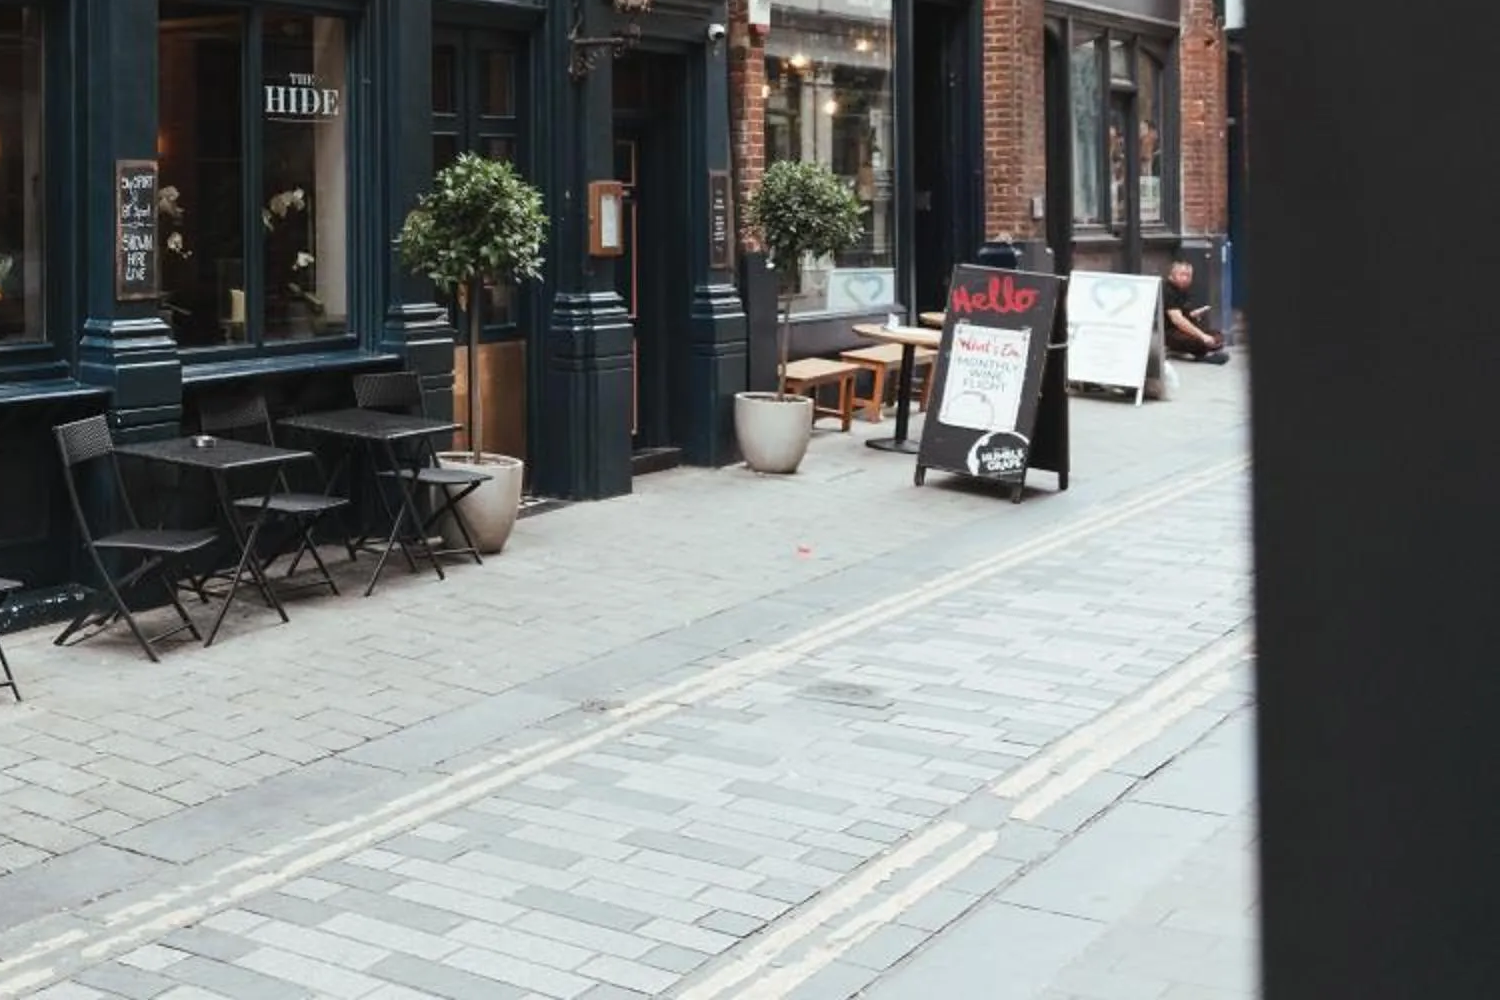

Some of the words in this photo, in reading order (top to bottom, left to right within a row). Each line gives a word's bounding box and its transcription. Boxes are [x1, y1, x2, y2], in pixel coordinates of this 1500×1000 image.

[289, 72, 316, 86] THE
[264, 85, 339, 116] HIDE
[952, 275, 1040, 313] Hello
